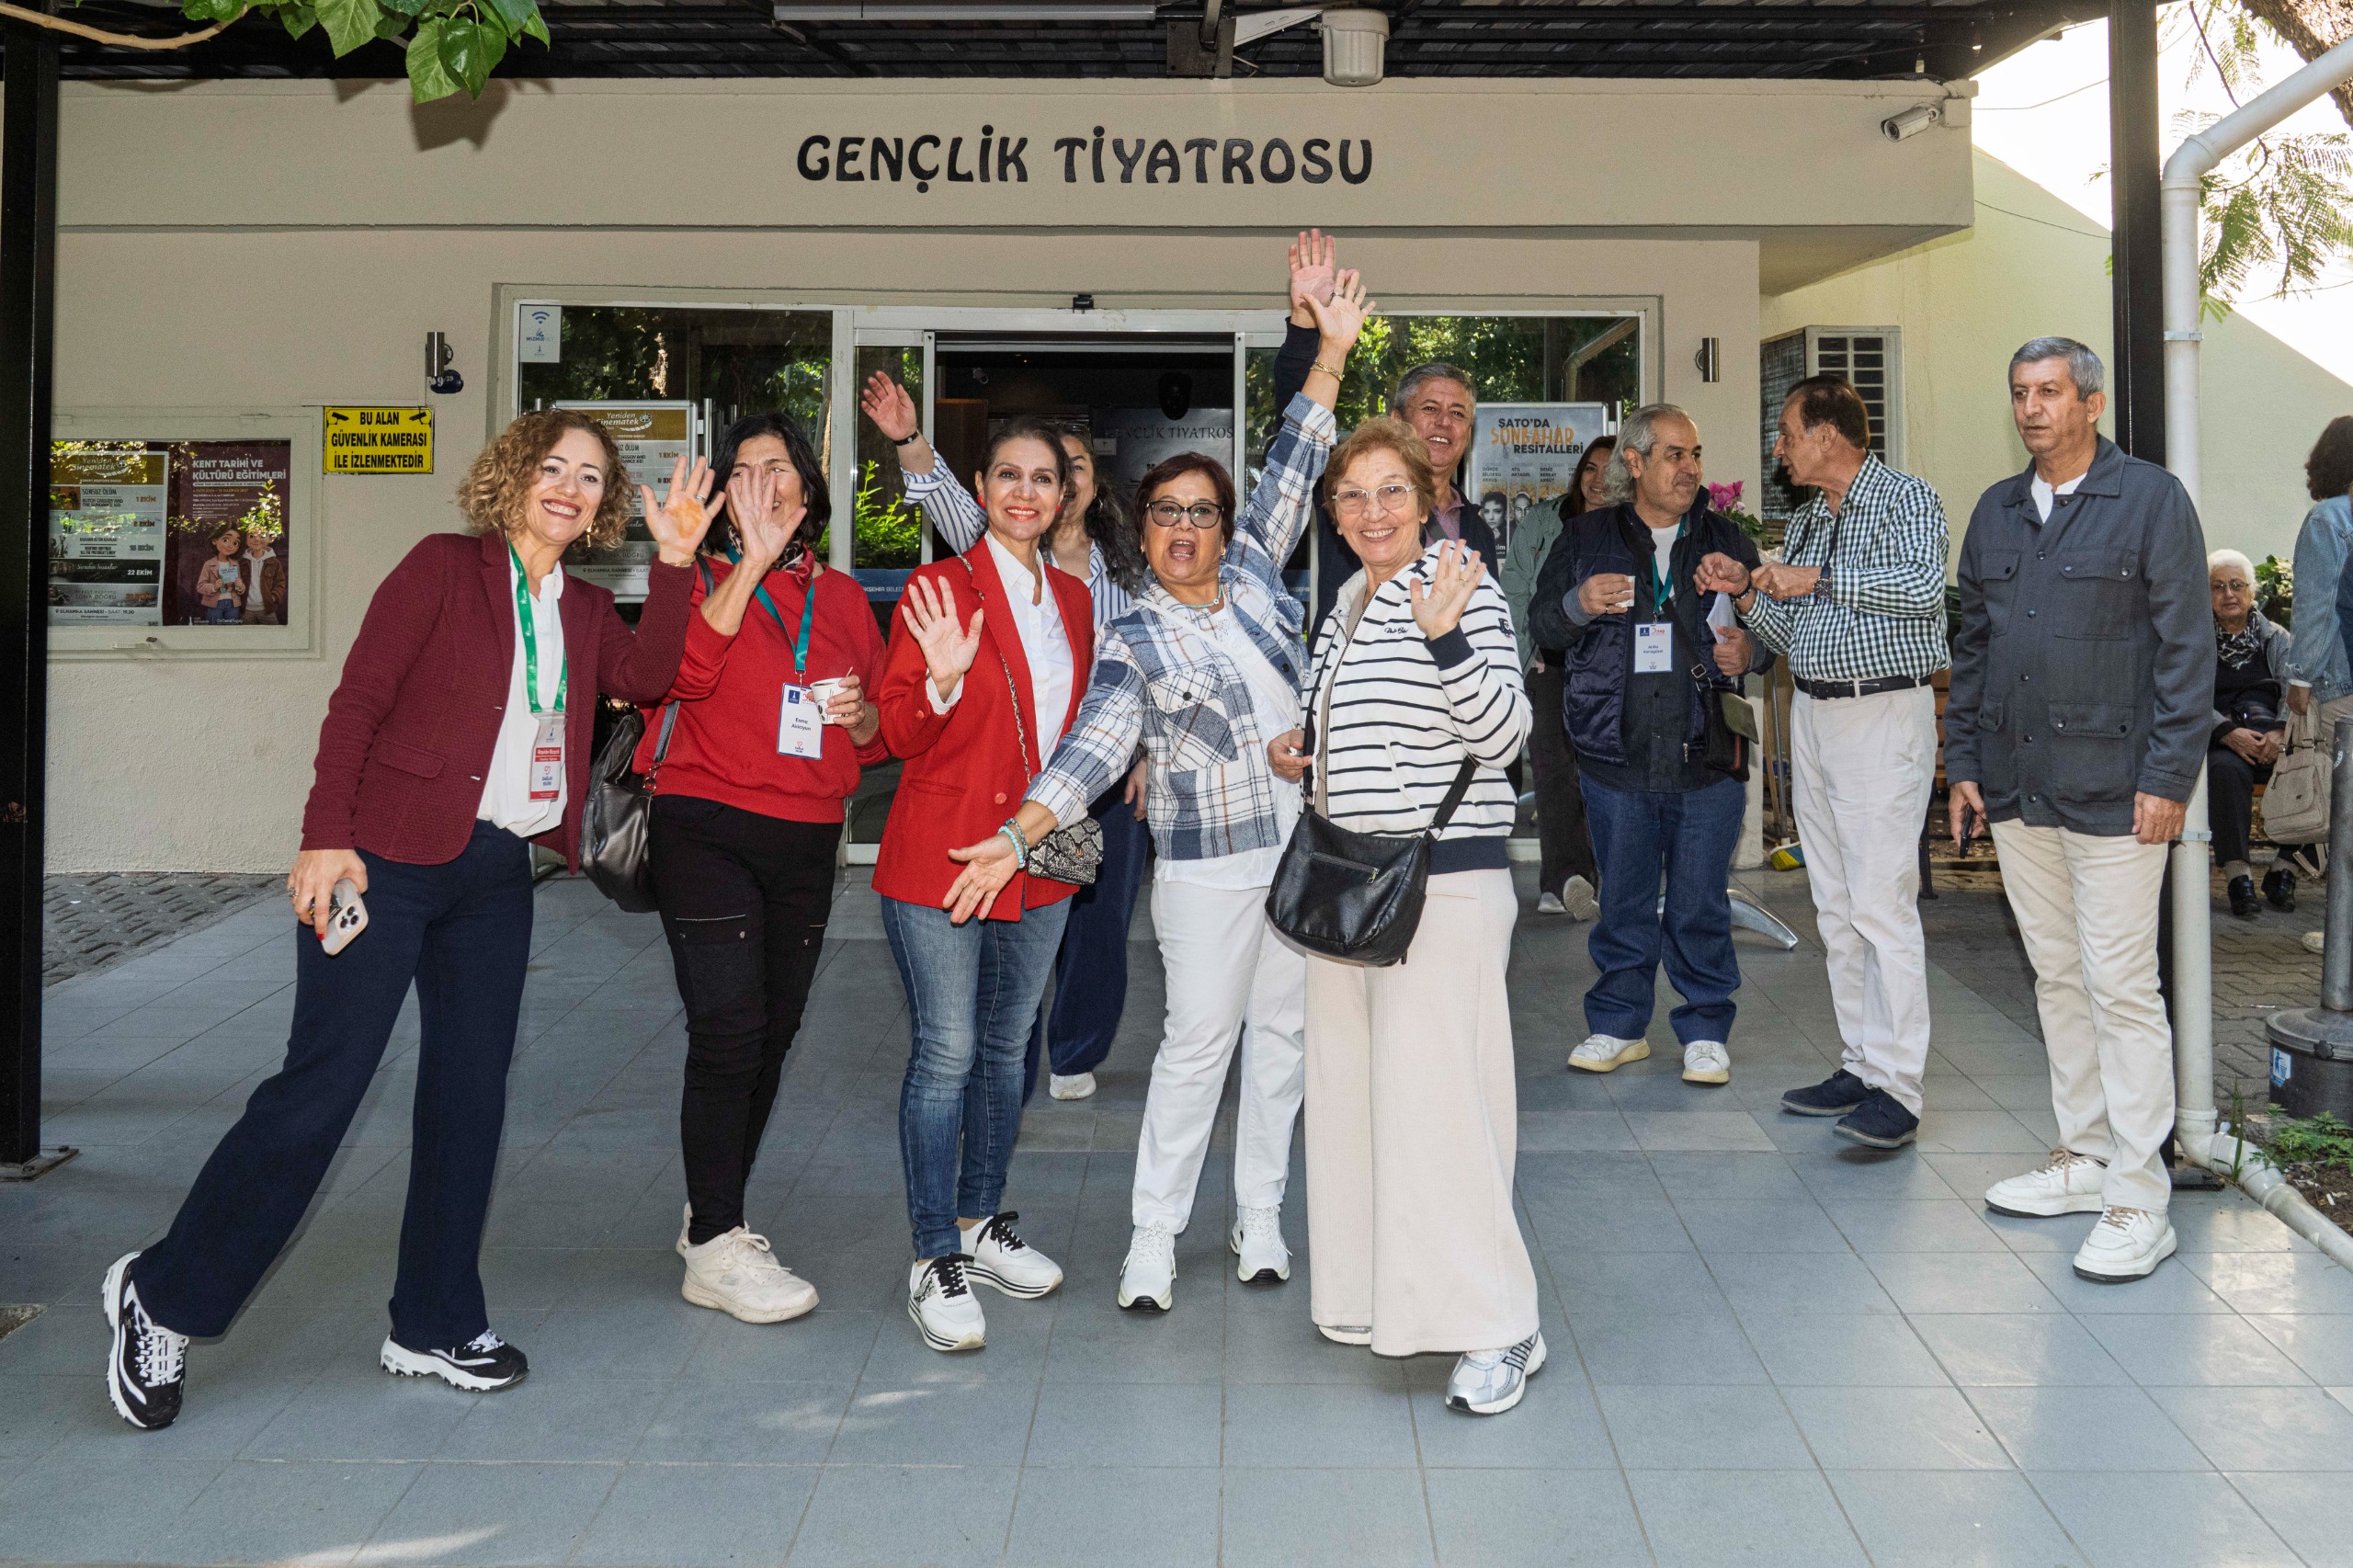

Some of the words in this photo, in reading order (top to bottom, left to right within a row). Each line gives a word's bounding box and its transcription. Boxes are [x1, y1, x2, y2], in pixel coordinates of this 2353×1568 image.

[796, 124, 1029, 193] GENÇLİK
[1054, 125, 1373, 185] TİYATROSU
[359, 412, 372, 425] BU
[375, 412, 400, 425] ALAN
[331, 429, 379, 448] GÜVENLİK
[380, 432, 427, 448] KAMERASI
[1168, 426, 1233, 439] TİYATROS
[1490, 426, 1574, 447] SONBAHAR
[1513, 442, 1584, 454] RESİTALLERİ
[192, 460, 217, 468] KENT
[219, 458, 249, 468] TARİHİ
[251, 460, 264, 468] VE
[334, 450, 348, 468] İLE
[350, 450, 424, 468] İZLENMEKTEDİR
[192, 470, 234, 480] KÜLTÜRÜ
[236, 469, 287, 480] EĞİTİMLERİ
[136, 568, 153, 576] EKİM
